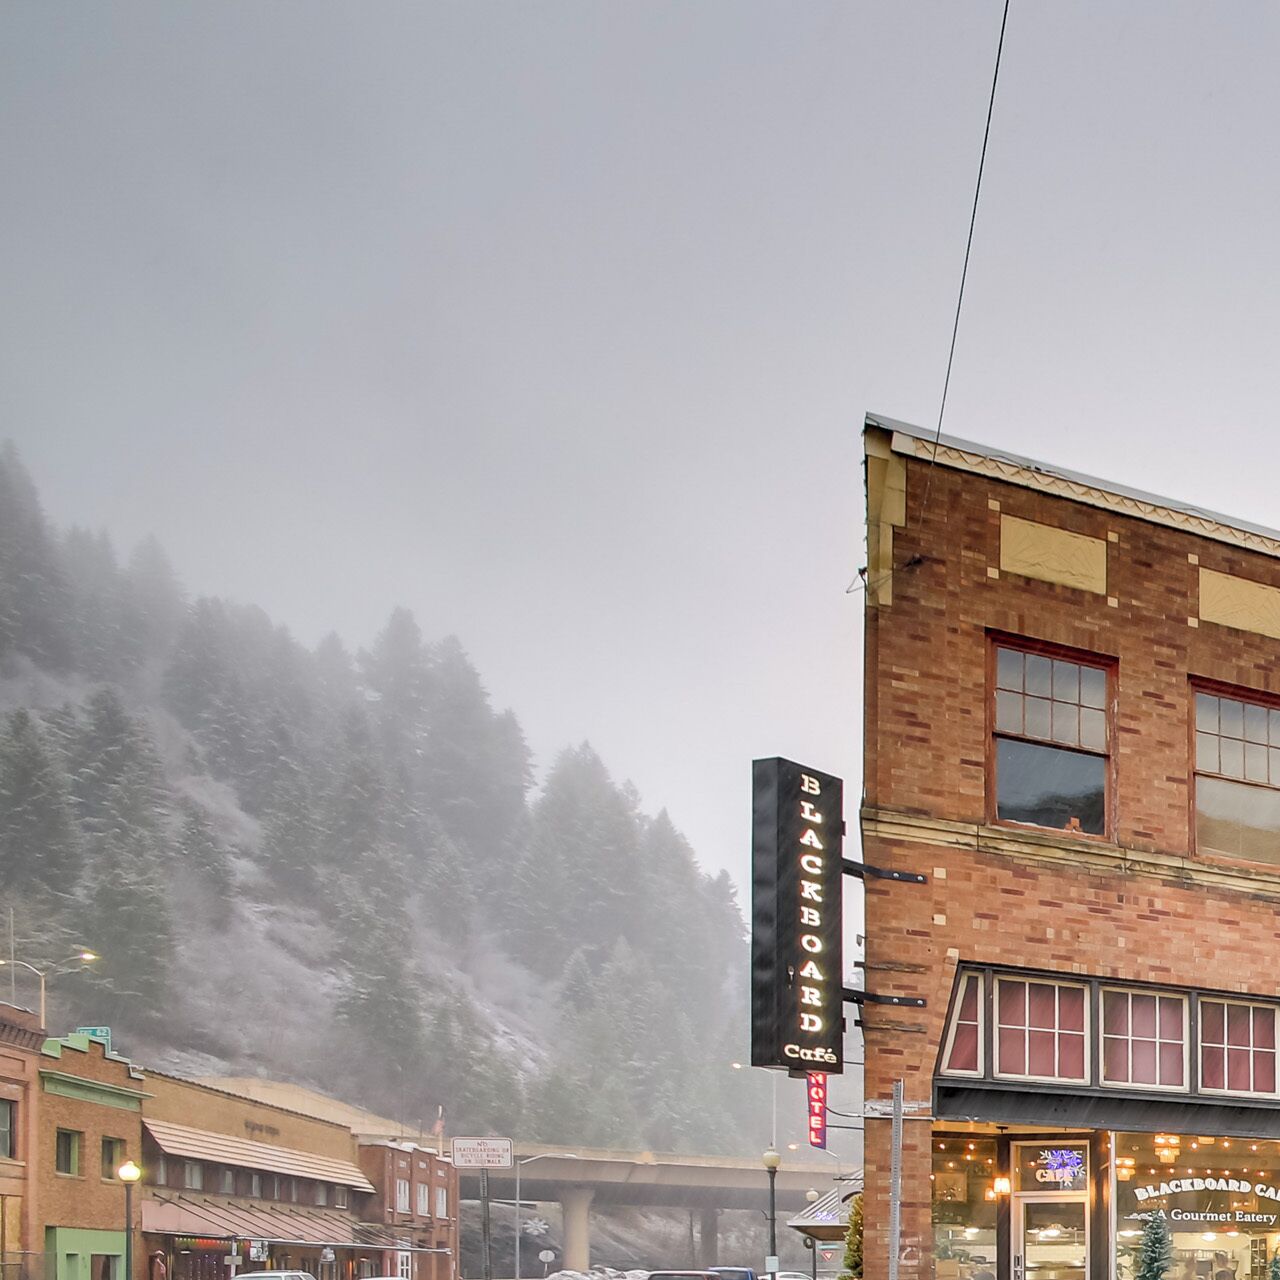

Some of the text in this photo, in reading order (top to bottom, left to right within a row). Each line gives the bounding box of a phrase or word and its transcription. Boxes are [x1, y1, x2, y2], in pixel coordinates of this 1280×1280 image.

[799, 773, 824, 1033] BLACKBOARD
[784, 1044, 838, 1064] Café
[1134, 1178, 1252, 1201] BLACKBOARD
[1171, 1209, 1232, 1222] Gourmet
[1235, 1210, 1278, 1226] Eatery
